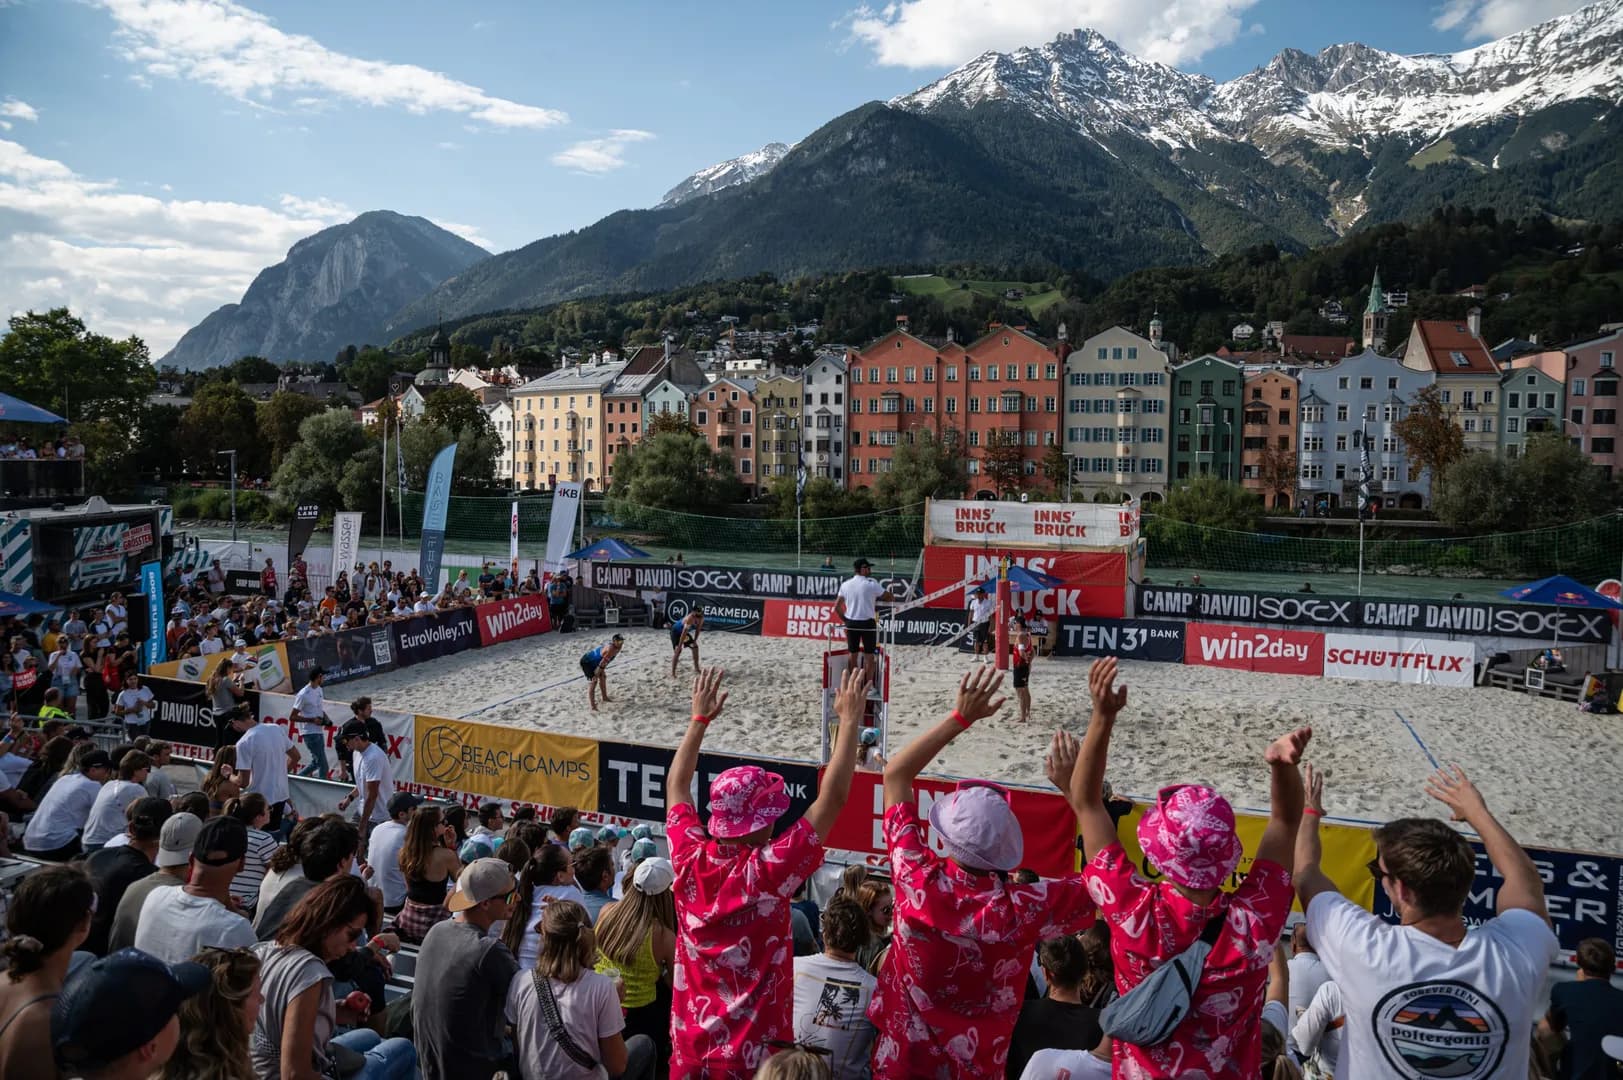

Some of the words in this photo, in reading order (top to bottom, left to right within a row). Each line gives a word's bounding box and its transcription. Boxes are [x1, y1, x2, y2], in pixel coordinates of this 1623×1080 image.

[955, 508, 995, 520] INNS'
[1034, 510, 1076, 523] INNS'
[955, 521, 1006, 534] BRUCK
[1034, 524, 1087, 538] BRUCK
[596, 566, 631, 586] CAMP
[635, 568, 672, 588] DAVID
[752, 573, 793, 594] CAMP
[797, 575, 838, 596] DAVID
[702, 606, 759, 619] EAKMEDIA
[788, 604, 836, 620] INNS'
[1143, 590, 1193, 613] CAMP
[1200, 593, 1251, 617] DAVID
[907, 620, 935, 634] DAVID
[1363, 602, 1420, 626] CAMP
[1425, 605, 1486, 631] DAVID
[400, 619, 473, 649] EuroVolley.TV
[786, 620, 848, 638] BRUCK
[1063, 624, 1117, 650] TEN
[1120, 628, 1148, 651] 31
[1150, 628, 1179, 639] BANK
[1326, 648, 1464, 673] SCHÜTTFLIX
[161, 701, 194, 725] DAVID
[461, 744, 591, 782] BEACHCAMPS
[462, 763, 500, 777] AUSTRIA
[1567, 860, 1609, 891] &
[1402, 986, 1453, 1001] FOREVER
